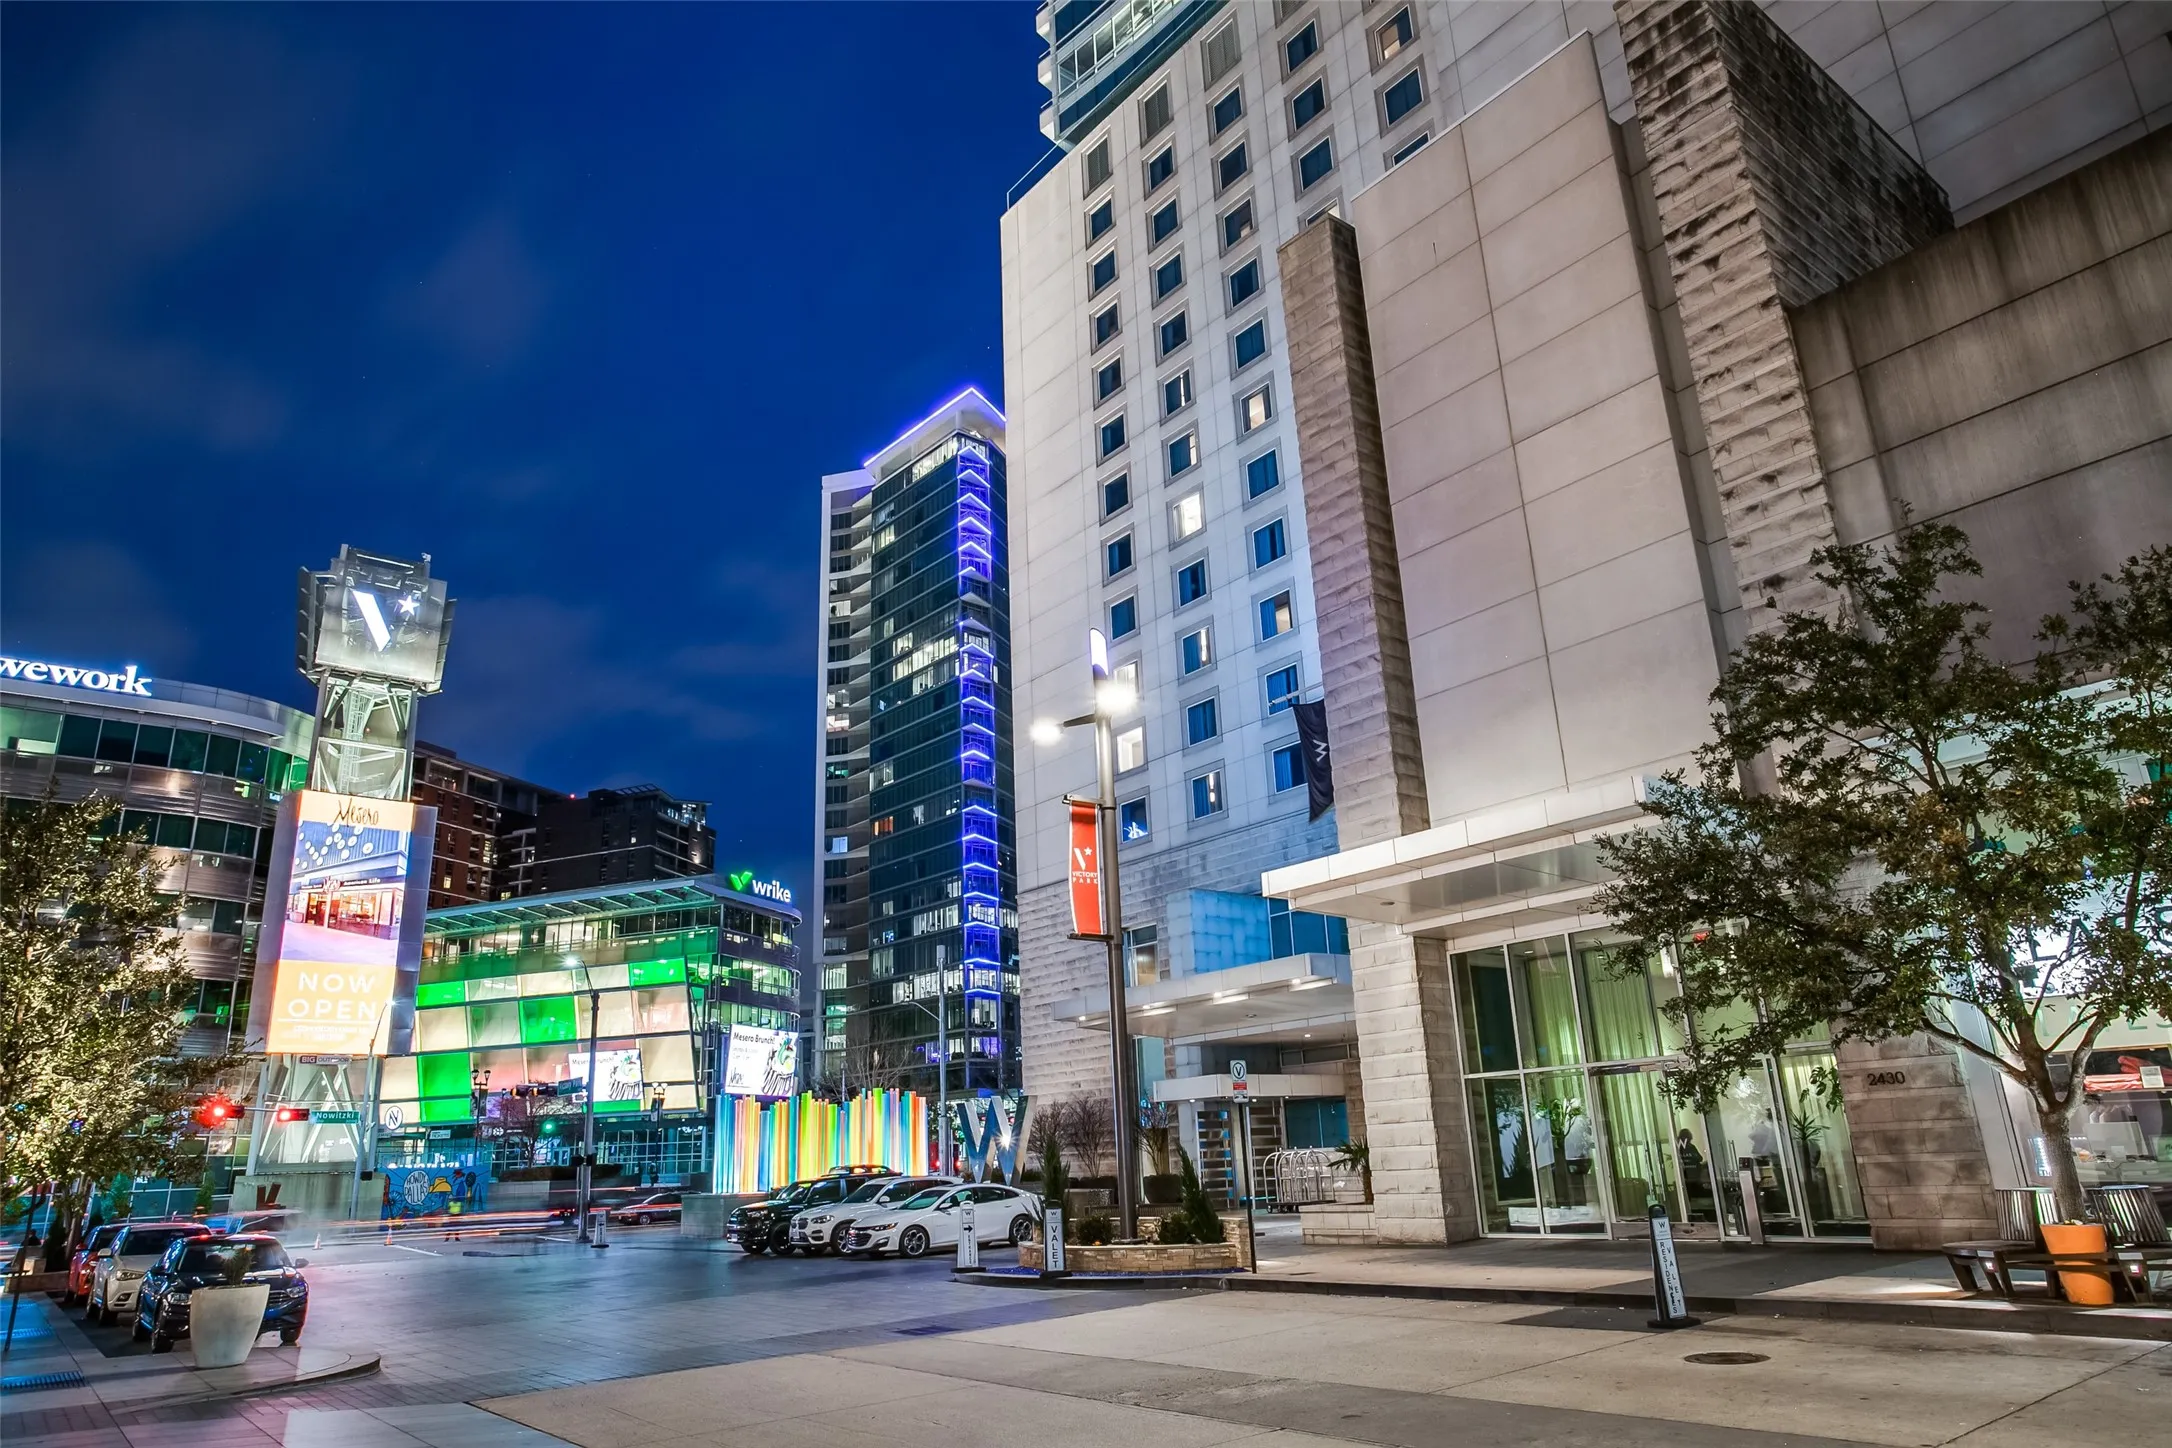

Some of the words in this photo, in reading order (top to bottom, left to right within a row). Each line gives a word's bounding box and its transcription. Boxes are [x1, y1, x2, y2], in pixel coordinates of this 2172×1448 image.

[0, 657, 153, 697] wework
[332, 797, 379, 828] Mesero
[752, 879, 792, 903] wrike
[298, 970, 376, 993] NOW
[287, 997, 378, 1020] OPEN
[733, 1031, 754, 1042] Mesero
[1867, 1071, 1906, 1086] 2430
[316, 1111, 355, 1120] Nowitzki
[404, 1182, 429, 1204] DALLAS
[1658, 1221, 1666, 1229] W
[1050, 1225, 1059, 1269] VALET
[1659, 1241, 1678, 1314] RESIDENCES
[1666, 1246, 1682, 1307] VALET
